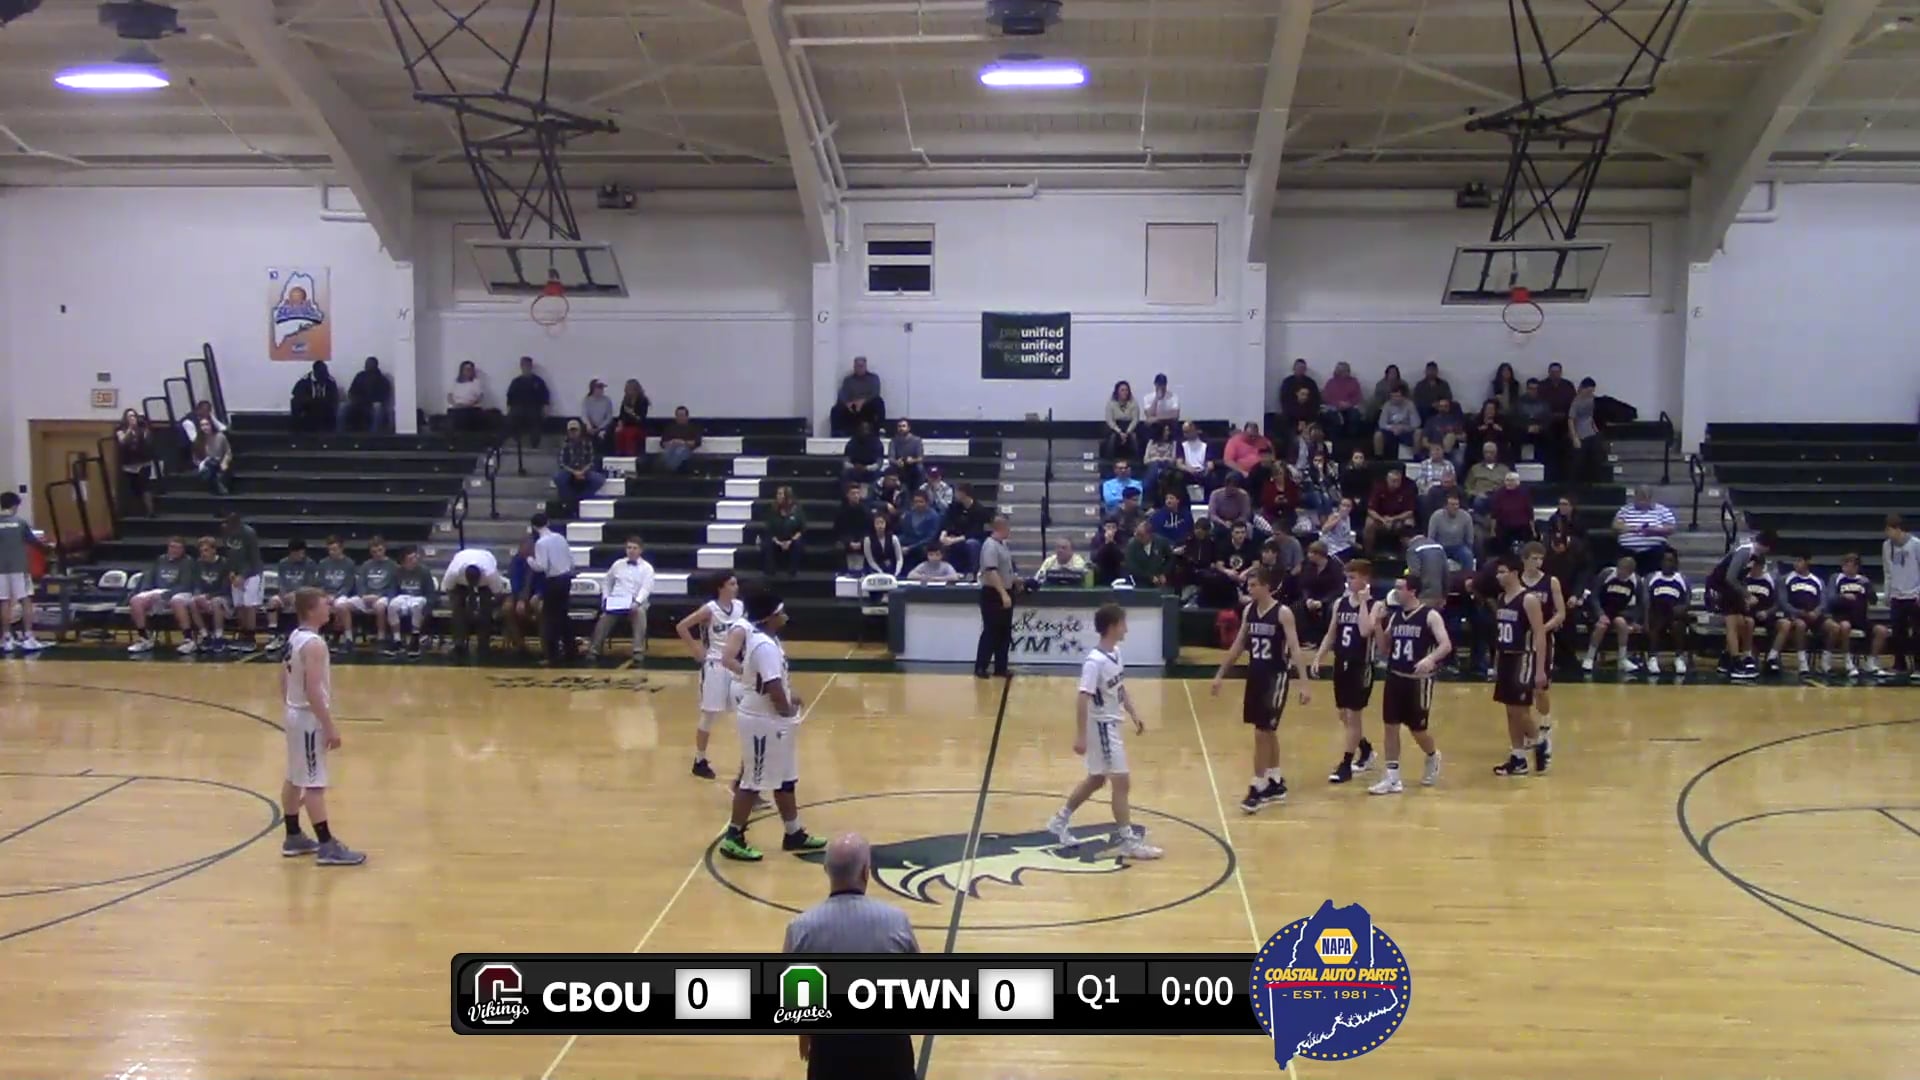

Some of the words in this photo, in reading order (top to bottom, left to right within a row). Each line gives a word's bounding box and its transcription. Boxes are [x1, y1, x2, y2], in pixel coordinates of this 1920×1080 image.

[816, 310, 830, 324] G
[1008, 636, 1051, 652] YM
[1341, 626, 1353, 647] 5
[1251, 637, 1272, 659] 22
[1391, 639, 1414, 661] 34
